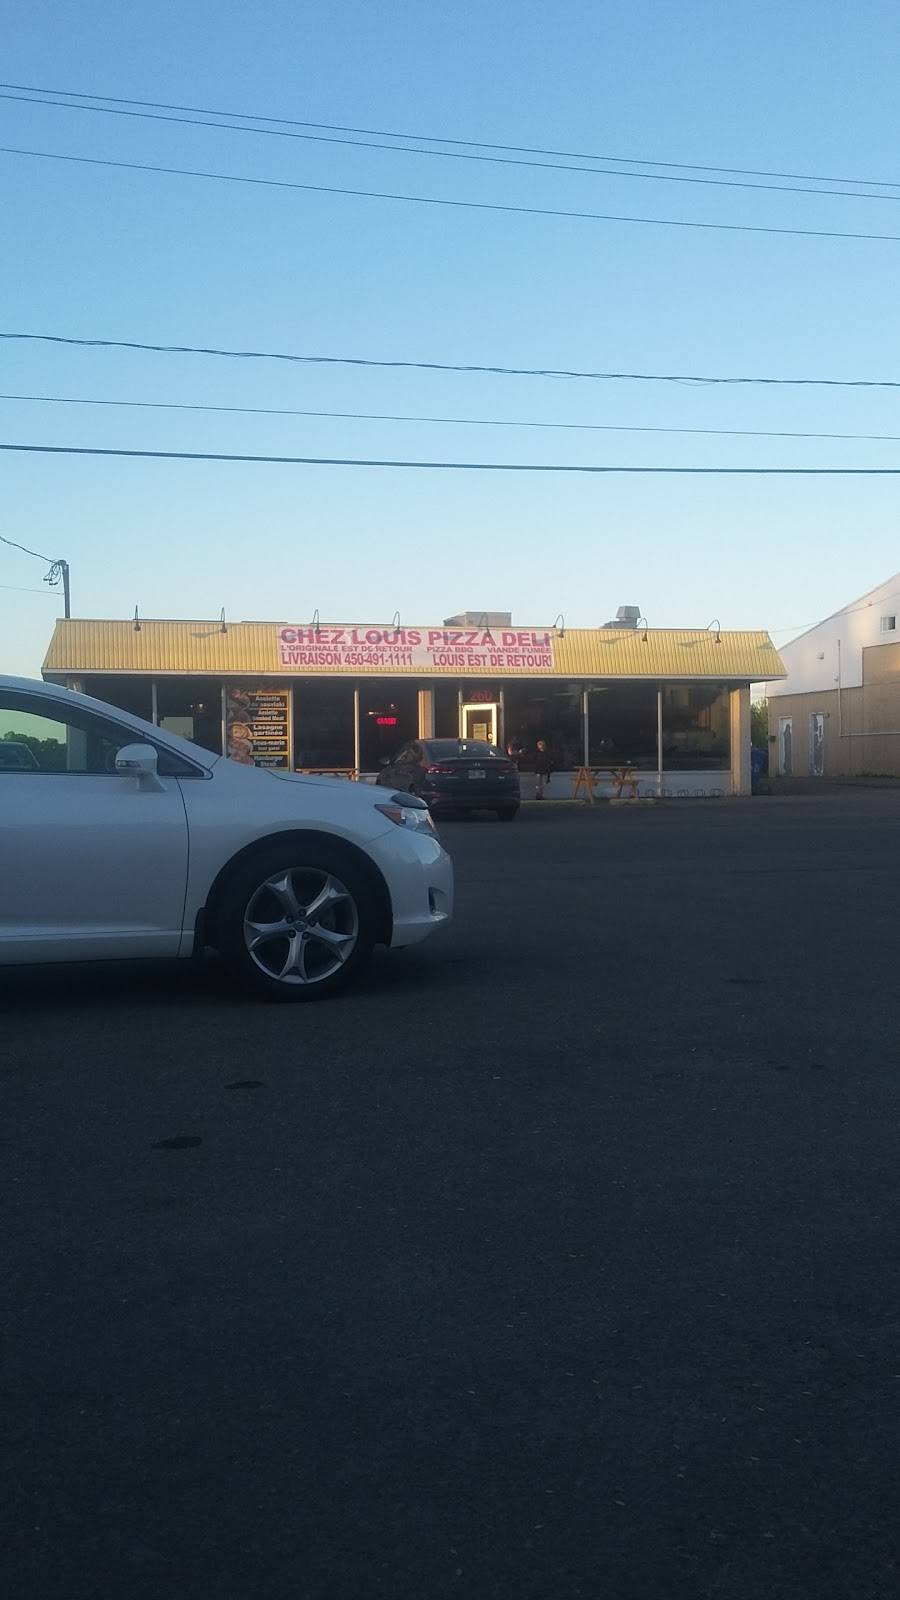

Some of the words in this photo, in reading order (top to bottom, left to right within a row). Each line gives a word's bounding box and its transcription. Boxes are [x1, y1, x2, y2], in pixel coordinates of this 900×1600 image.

[281, 628, 346, 644] CHEZ
[352, 629, 422, 645] LOUIS
[428, 631, 497, 646] PIZZA
[501, 632, 552, 647] DELI
[282, 653, 341, 665] LIVRAISON
[344, 653, 413, 666] 450-491-1111
[433, 654, 465, 666] LOUIS
[468, 655, 487, 666] EST
[490, 655, 505, 666] DE
